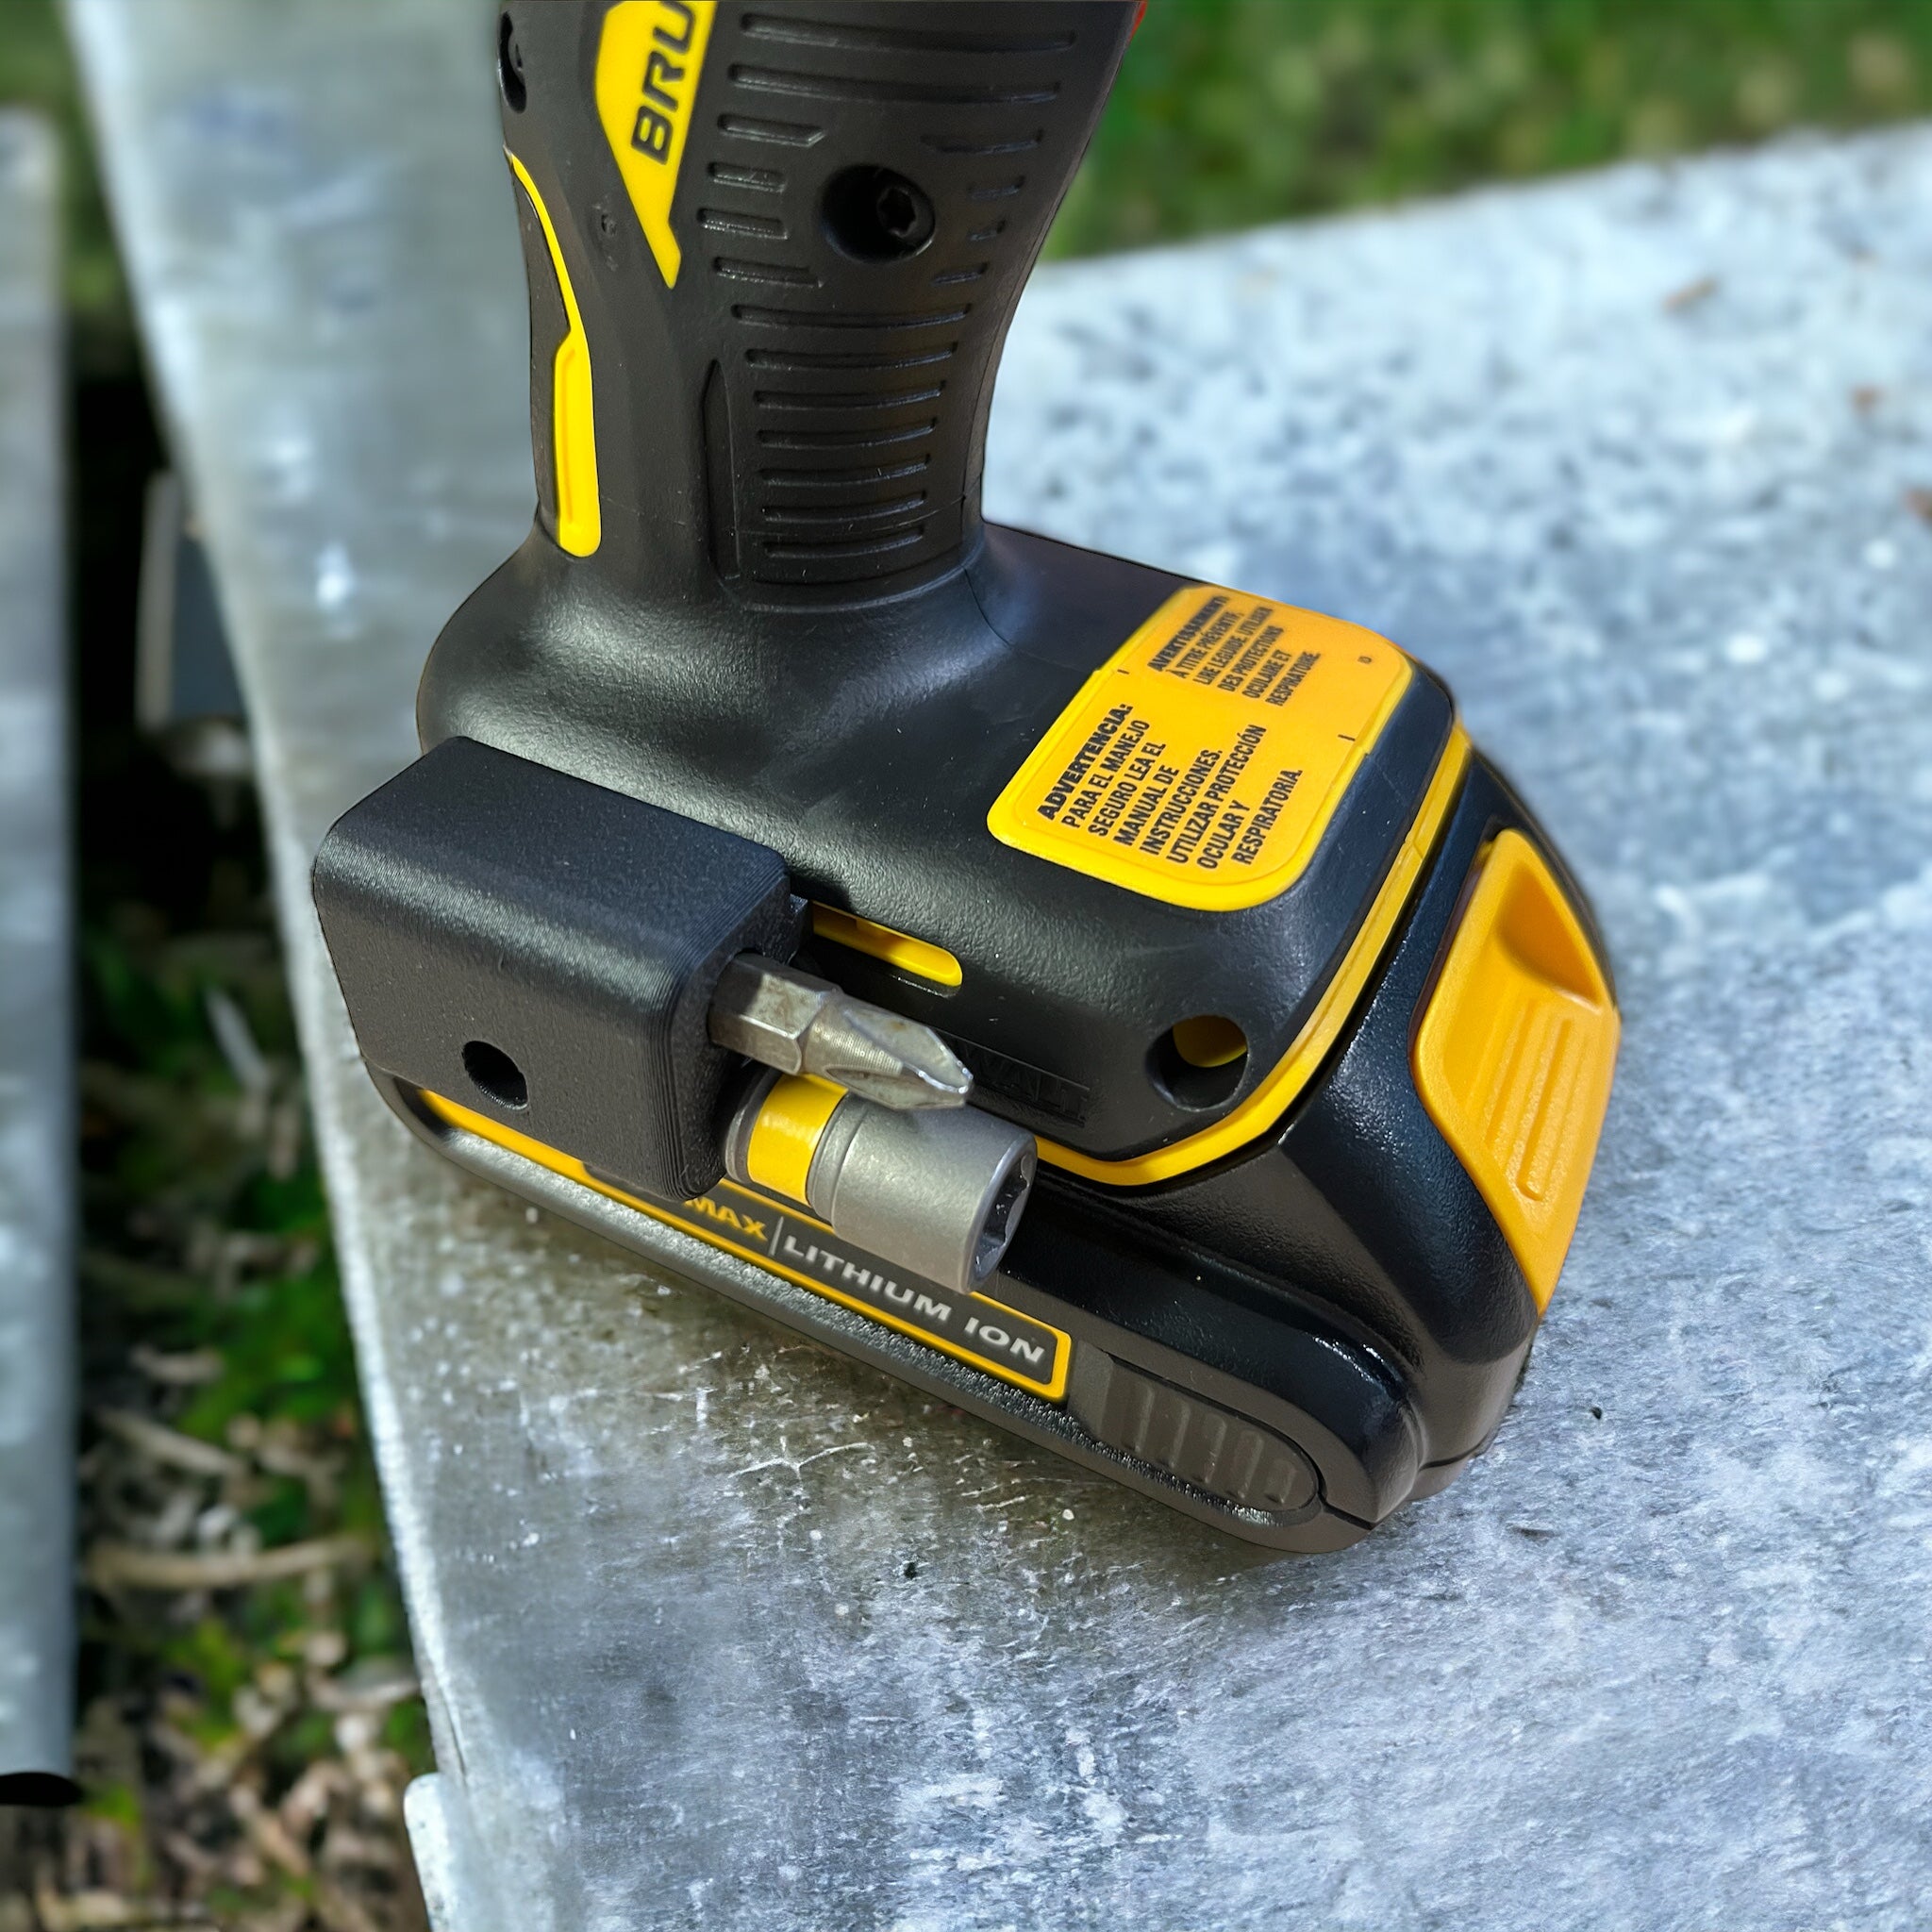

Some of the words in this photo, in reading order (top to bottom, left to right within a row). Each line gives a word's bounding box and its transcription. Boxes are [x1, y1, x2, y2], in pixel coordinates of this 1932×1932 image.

[1176, 642, 1208, 675] TITRE
[1193, 663, 1221, 685] LIRE
[1238, 607, 1274, 636] UTILISER
[1217, 675, 1243, 691] DES
[1231, 625, 1284, 675] PROTECTIONS
[1242, 657, 1285, 698] OCULAIRE
[1273, 650, 1291, 661] ET
[1266, 652, 1321, 706] RESPIRATOIRE.
[1038, 705, 1133, 820] ADVERTENCIA:
[1089, 774, 1113, 789] EL
[1100, 721, 1149, 772] MANEJO
[1061, 791, 1102, 827] PARA
[1089, 782, 1137, 836] SEGURO
[1124, 758, 1155, 781] LEA
[1141, 742, 1166, 757] EL
[1113, 787, 1167, 845] MANUAL
[1153, 765, 1179, 785] DE
[1140, 750, 1222, 855] INSTRUCCIONES.
[1167, 802, 1219, 863] UTILIZAR
[1205, 725, 1266, 802] PROTECCIÓN
[1232, 771, 1302, 864] RESPIRATORIA.
[1197, 813, 1244, 868] OCULAR
[1229, 800, 1249, 810] Y
[684, 1196, 768, 1241] MAX
[782, 1234, 953, 1323] LITHIUM
[963, 1317, 1047, 1364] ION
